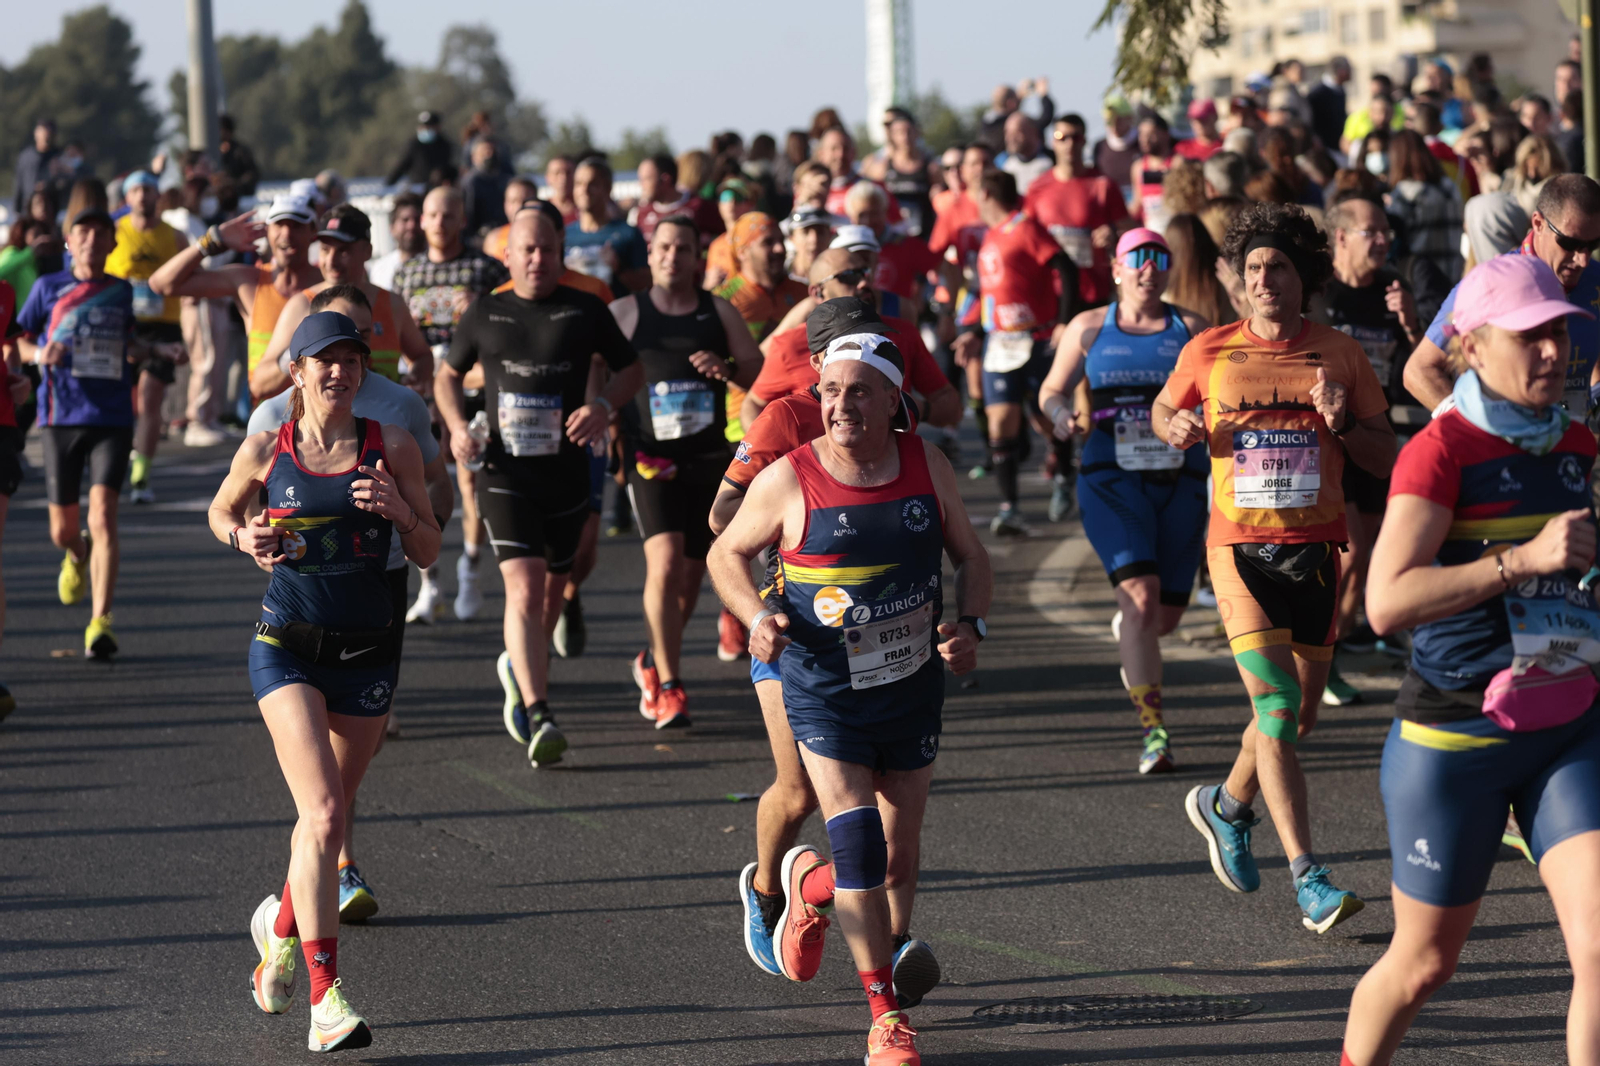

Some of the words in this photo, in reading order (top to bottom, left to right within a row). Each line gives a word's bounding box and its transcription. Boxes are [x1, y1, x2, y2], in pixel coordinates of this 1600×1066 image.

[1226, 375, 1252, 386] LOS
[671, 382, 707, 393] ZURICH
[516, 396, 557, 407] ZURICH
[1260, 433, 1309, 445] ZURICH
[1262, 458, 1290, 471] 6791
[1261, 478, 1293, 488] JORGE
[279, 500, 302, 508] AIMAR
[833, 528, 858, 537] AIMAR
[321, 561, 366, 573] CONSULTING
[874, 591, 925, 618] ZURICH
[879, 624, 911, 644] 8733
[884, 645, 912, 662] FRAN
